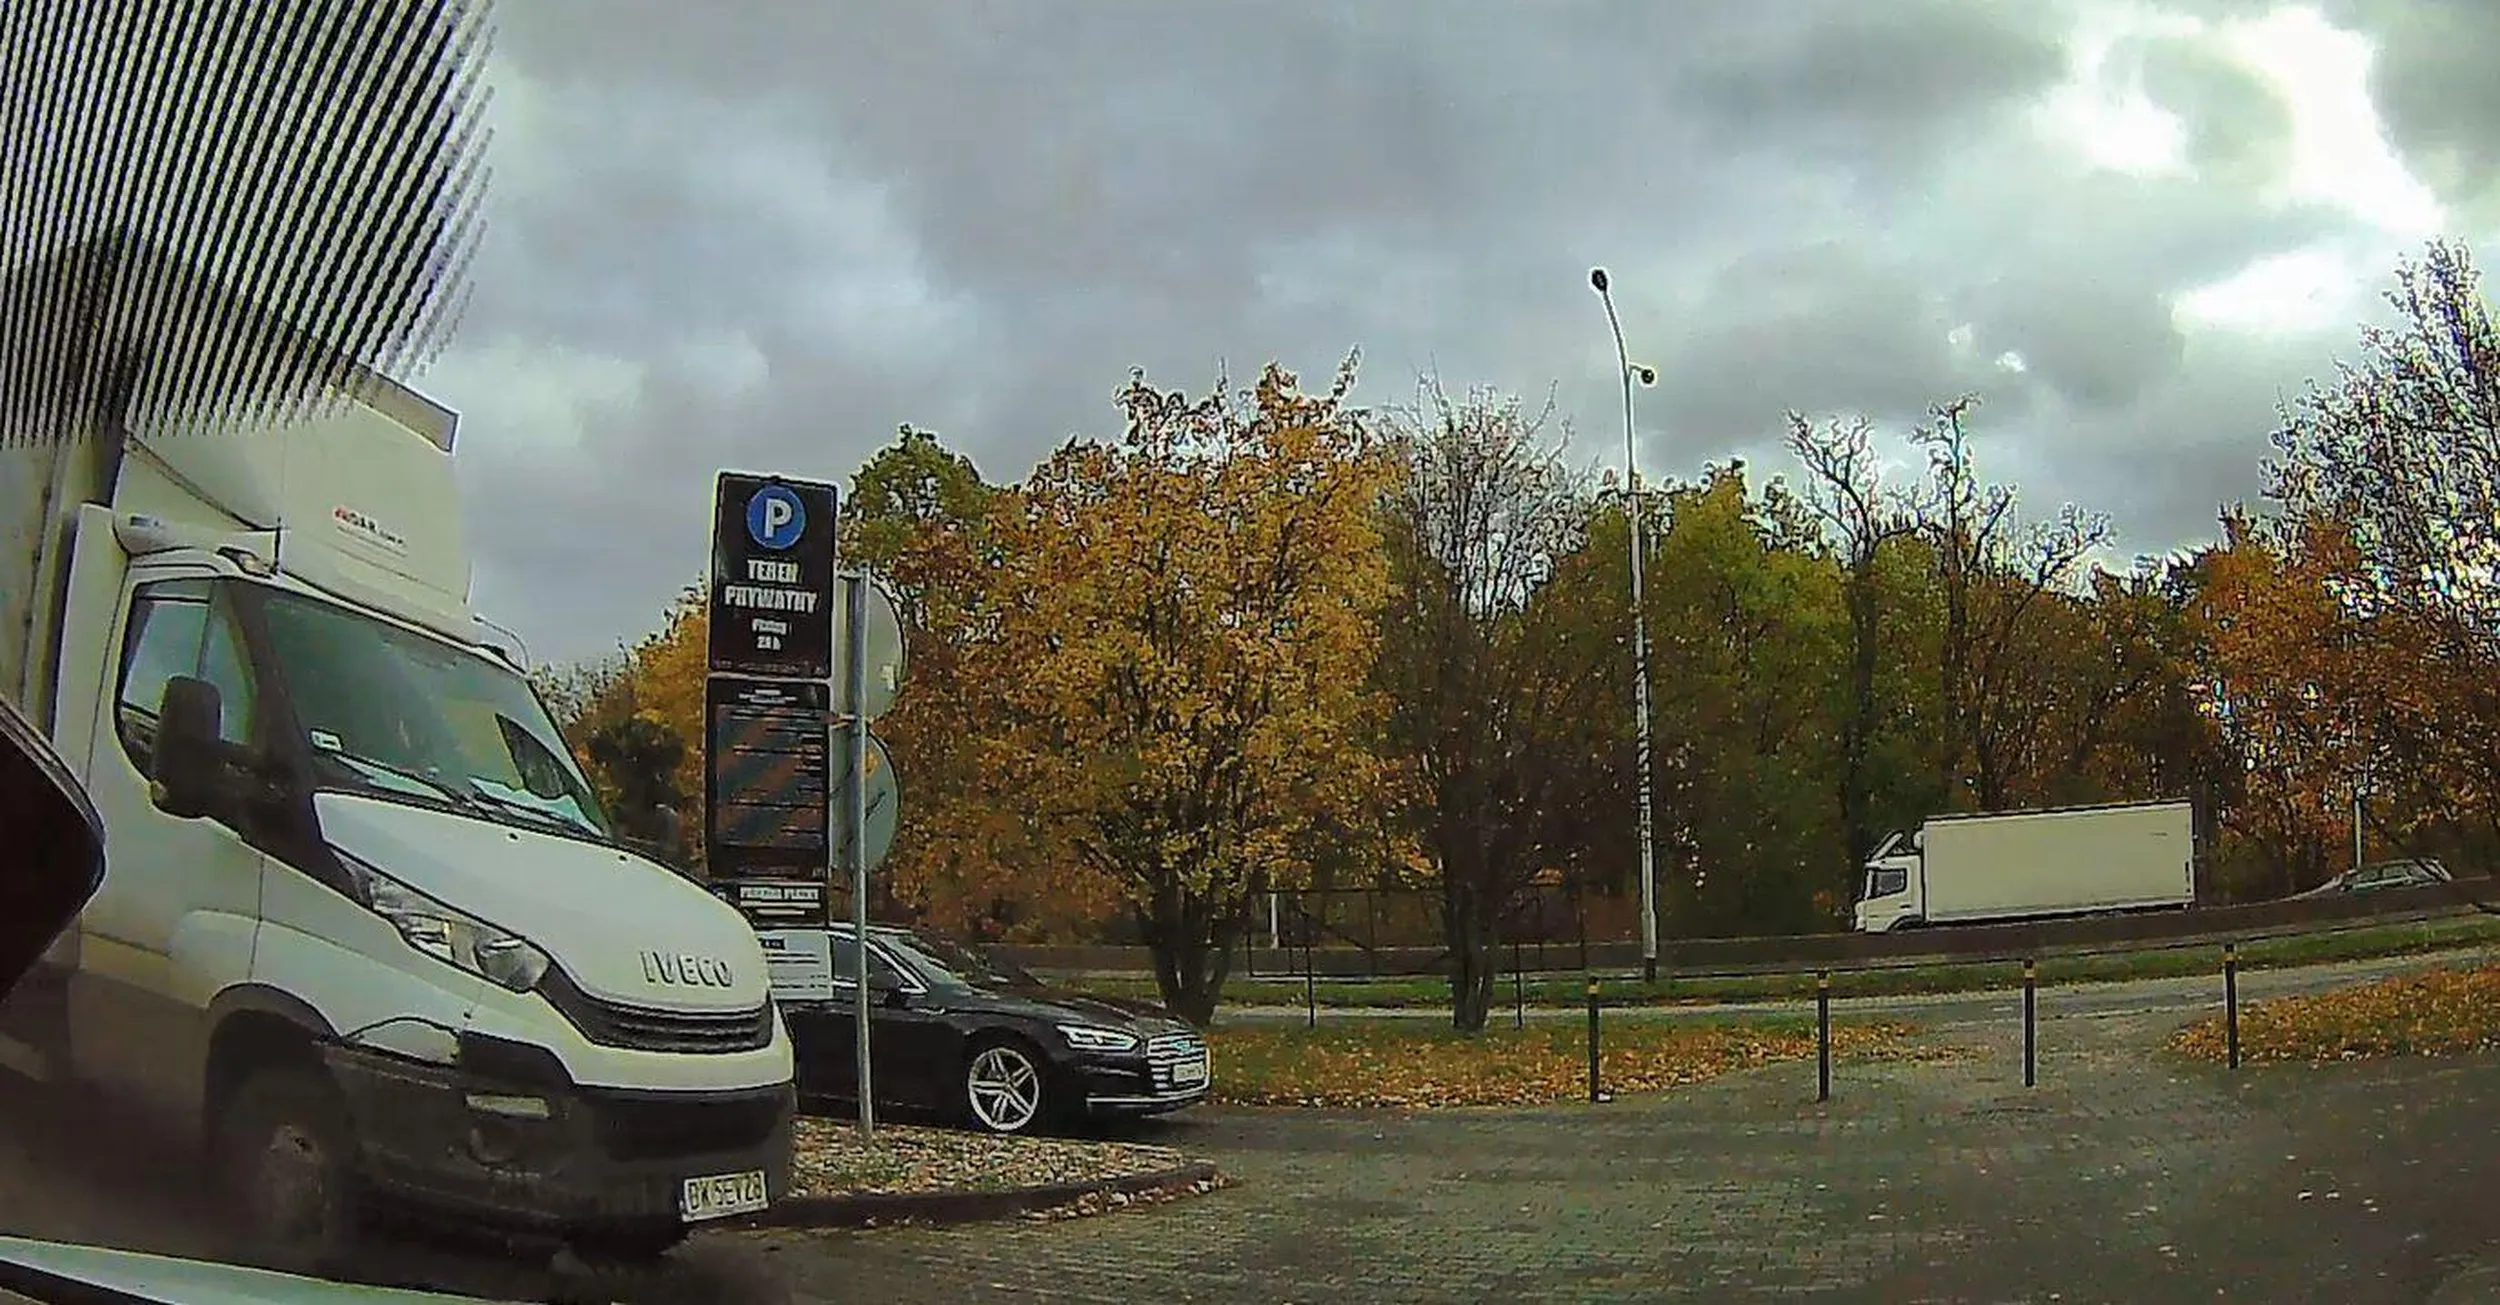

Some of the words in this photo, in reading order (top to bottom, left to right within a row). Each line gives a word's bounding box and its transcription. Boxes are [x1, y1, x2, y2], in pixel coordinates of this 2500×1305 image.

[764, 498, 792, 538] P
[747, 559, 799, 583] TEREN
[724, 585, 818, 614] PRYWATNY
[640, 950, 733, 988] IVECO
